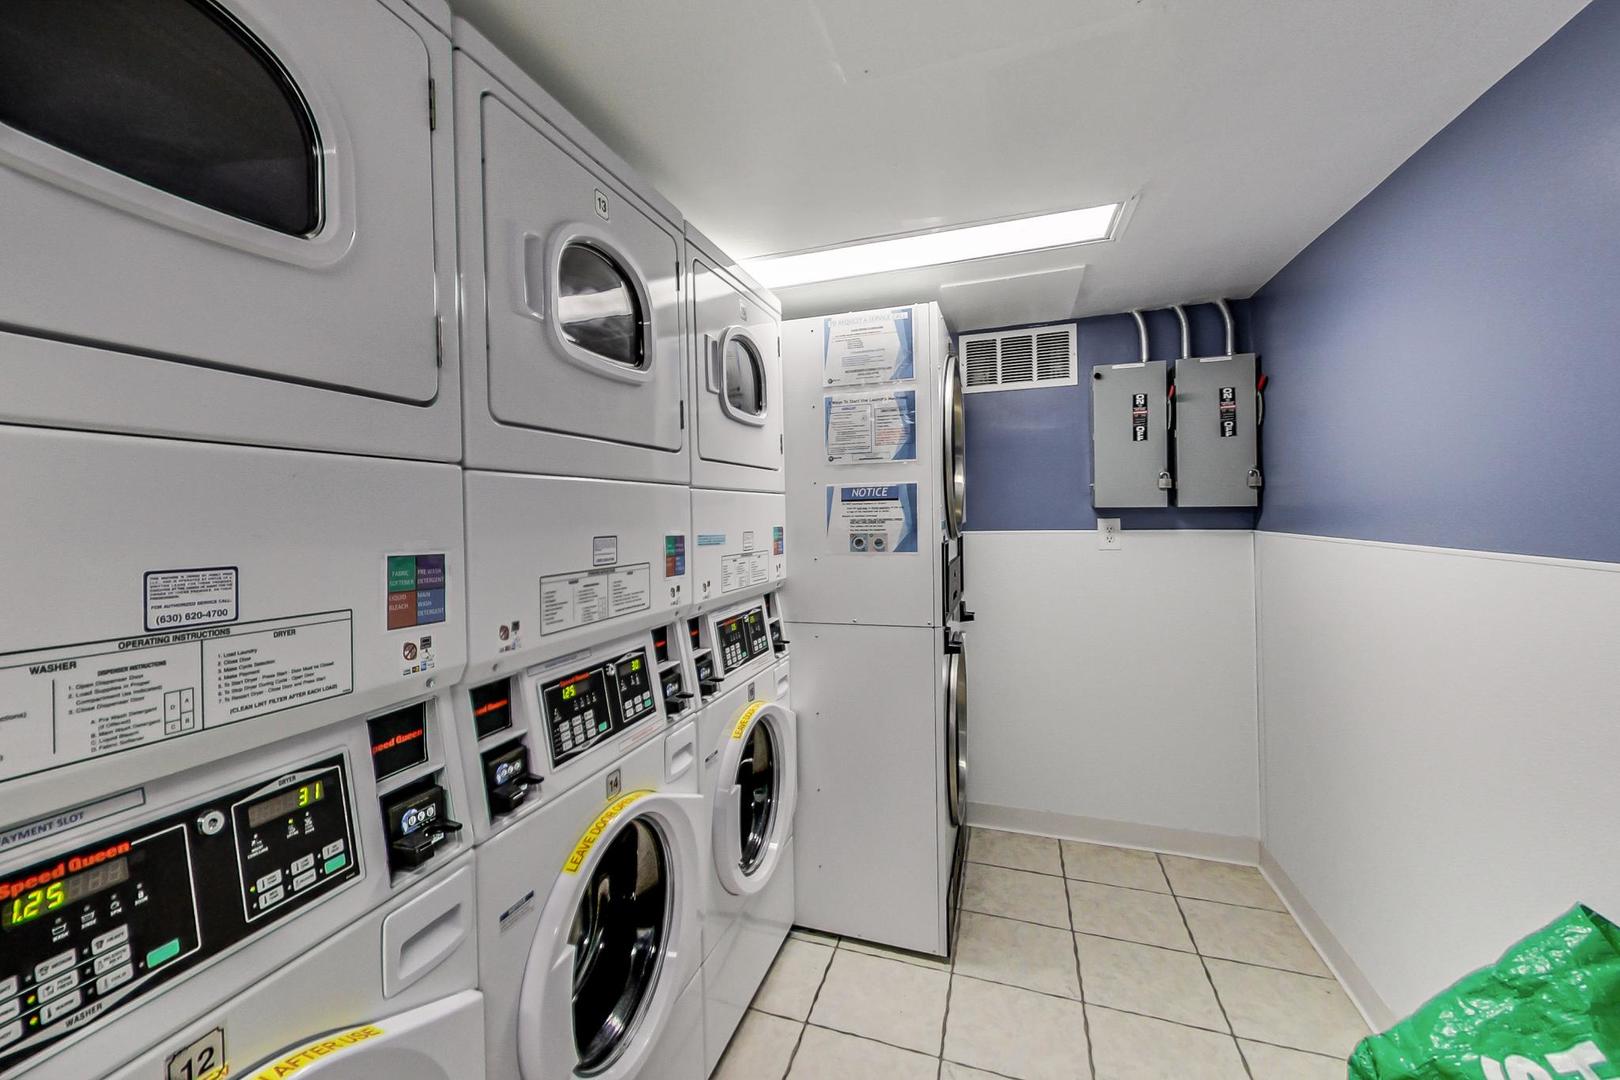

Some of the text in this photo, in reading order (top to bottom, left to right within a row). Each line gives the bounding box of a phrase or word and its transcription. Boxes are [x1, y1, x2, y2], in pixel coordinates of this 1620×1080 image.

[598, 197, 607, 213] 13
[1135, 393, 1145, 405] ON
[1223, 387, 1233, 399] ON
[1135, 425, 1145, 441] OFF
[1224, 421, 1234, 437] OFF
[851, 487, 889, 497] NOTICE
[156, 609, 229, 626] (630) 620-4700
[118, 628, 231, 650] OPERATING INSTRUCTIONS
[273, 628, 296, 638] DRYER
[29, 660, 77, 675] WASHER
[230, 704, 254, 715] (CLEAN
[254, 700, 267, 709] LINT
[268, 696, 287, 705] FILTER
[288, 690, 307, 700] AFTER
[307, 687, 322, 695] EACH
[322, 684, 338, 692] LOAD)
[371, 728, 423, 755] peed Queen
[278, 775, 297, 787] DRYER
[608, 777, 619, 791] 14
[298, 782, 320, 808] 31
[0, 811, 84, 847] AYMENT SLOT
[566, 835, 595, 872] LEAVE
[590, 810, 614, 836] DOOR
[0, 841, 131, 900] Speed Queen
[65, 1002, 103, 1028] WASHER
[273, 1025, 381, 1078] AFTER USE
[180, 1046, 215, 1080] 12
